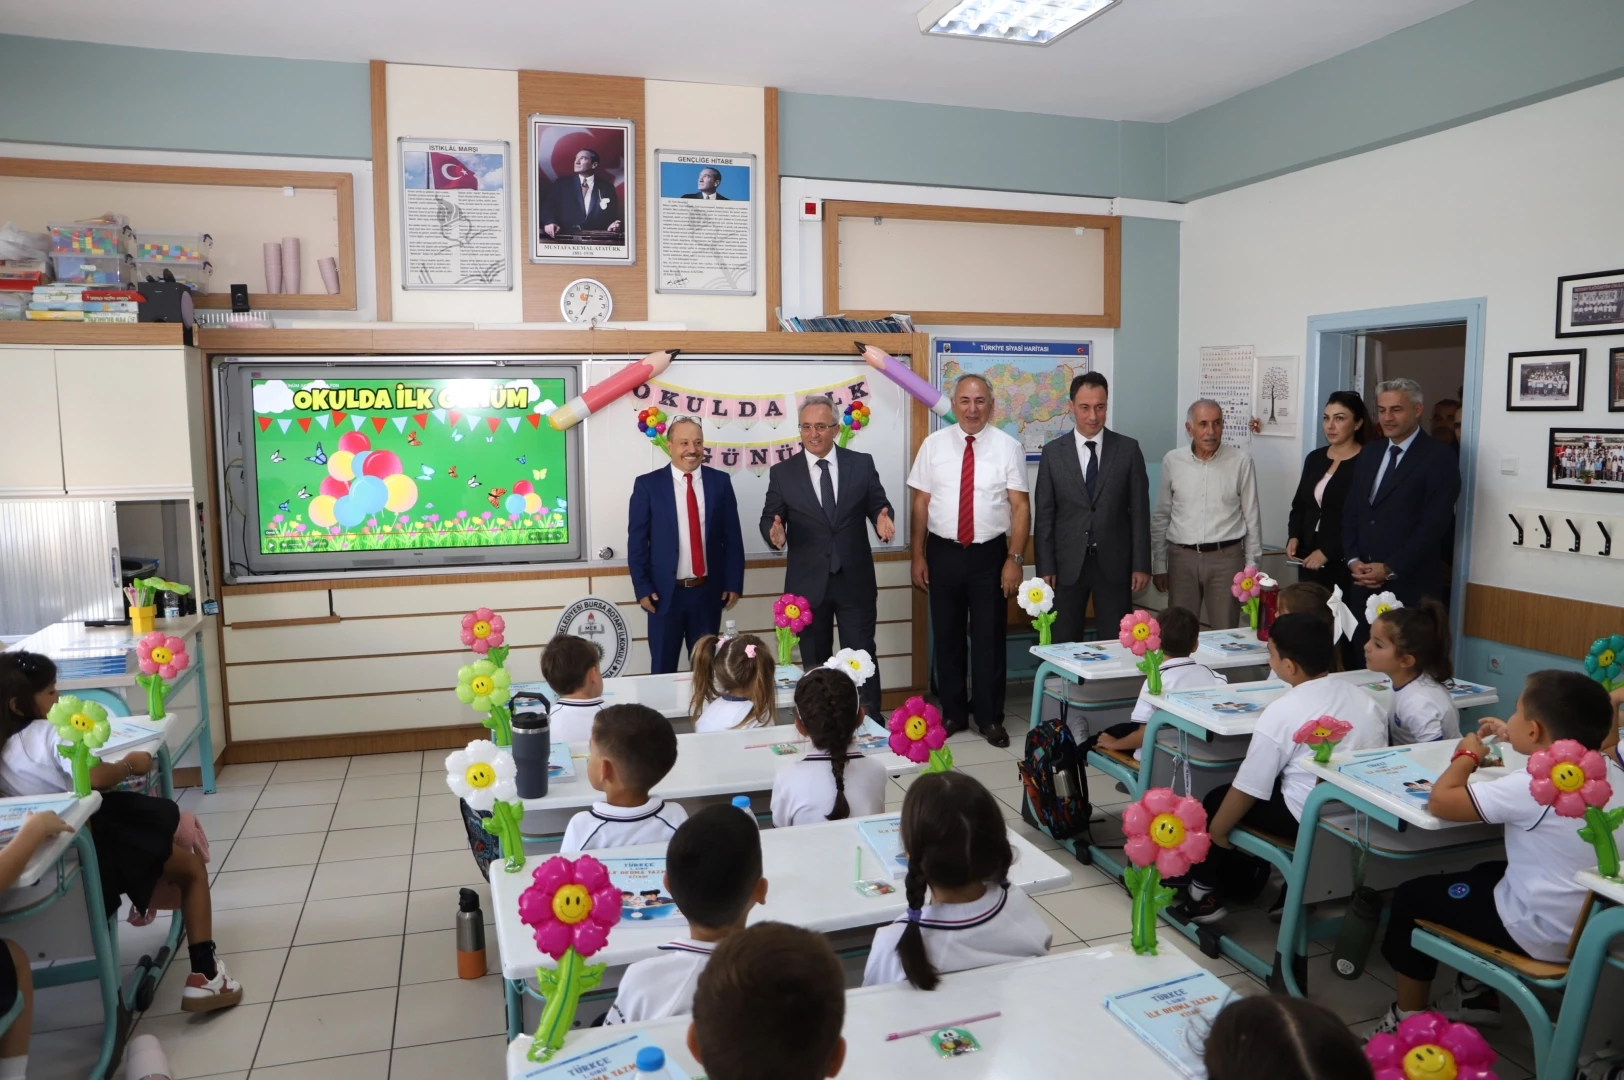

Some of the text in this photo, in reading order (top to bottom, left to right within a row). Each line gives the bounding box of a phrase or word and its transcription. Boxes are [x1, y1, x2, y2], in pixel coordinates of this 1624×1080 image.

[677, 156, 734, 165] GENÇLİĞE HİTABE
[980, 344, 1049, 353] TÜRKİYE SİYASİ HARİTASI
[293, 387, 394, 412] OKULDA
[396, 382, 434, 410] İLK
[633, 383, 784, 418] OKULDA
[583, 601, 607, 610] BURSA
[606, 608, 624, 631] ROTARY
[1151, 988, 1187, 1002] TÜRKÇE
[1144, 995, 1218, 1019] İLK OKUMA YAZMA
[567, 1057, 611, 1076] TÜRKÇE
[589, 1066, 608, 1077] SINIF
[610, 1062, 637, 1077] YAZM
